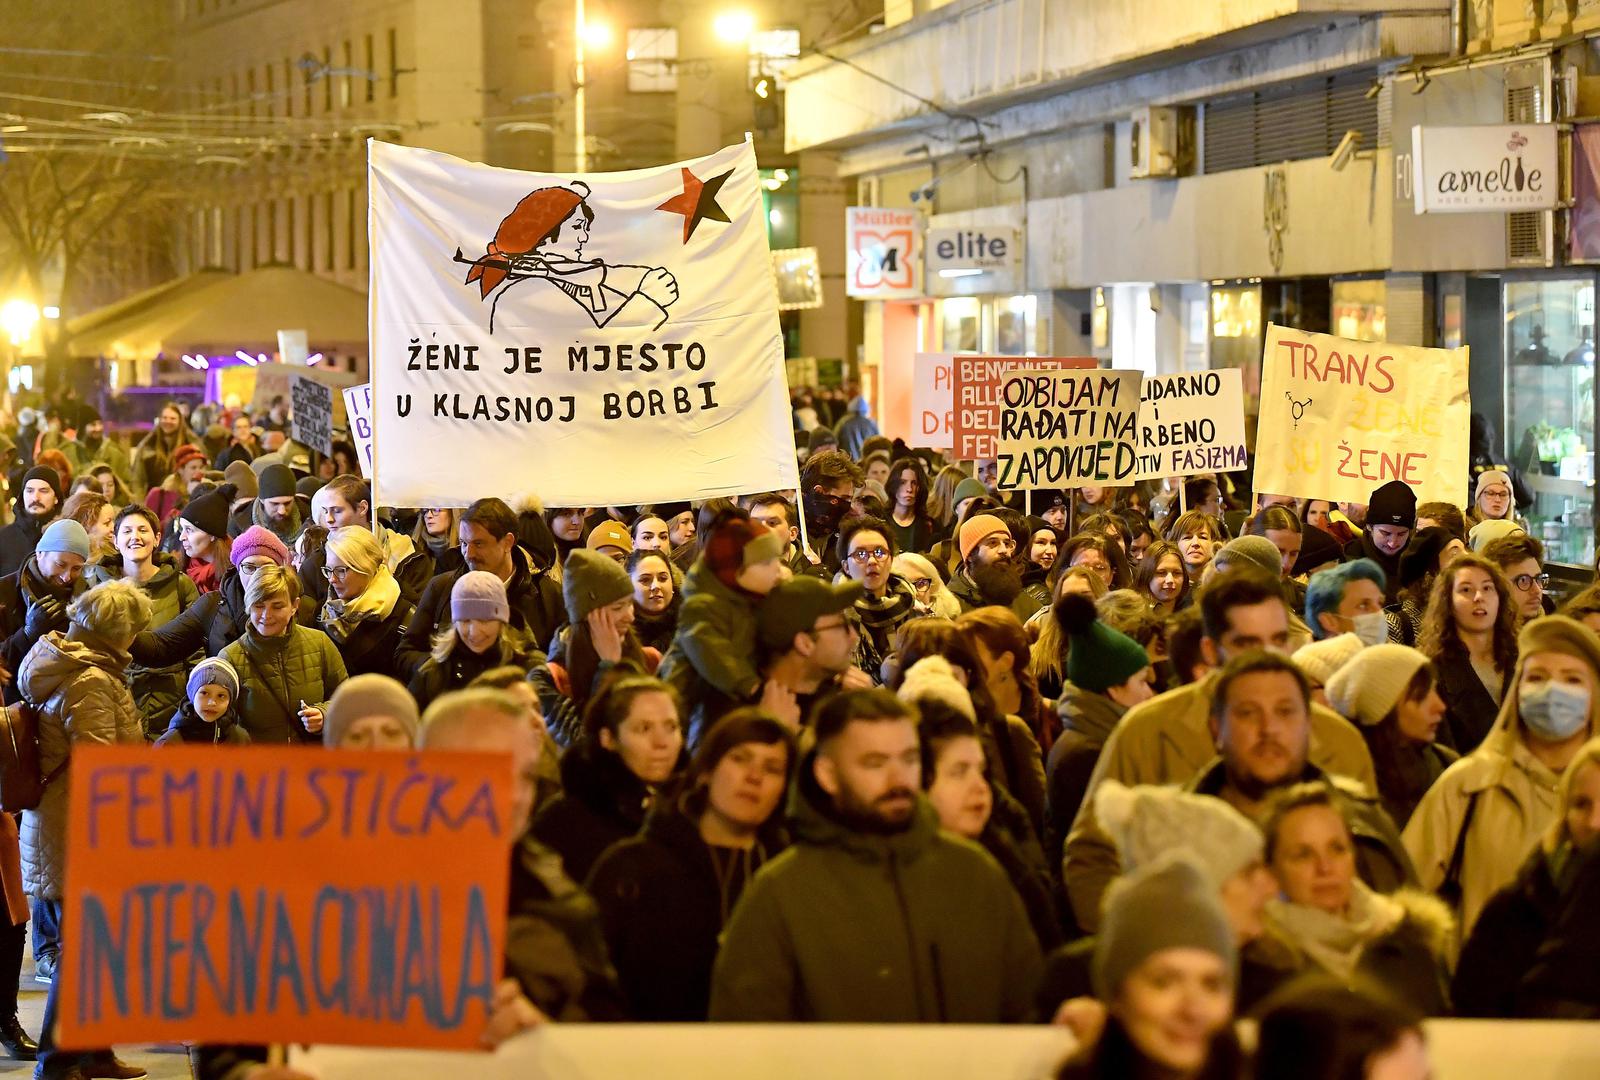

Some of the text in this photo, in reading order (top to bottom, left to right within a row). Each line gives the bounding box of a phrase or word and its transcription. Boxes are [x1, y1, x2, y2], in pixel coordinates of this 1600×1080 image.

[937, 232, 1006, 259] elite
[503, 347, 542, 374] JE
[568, 341, 706, 372] MJESTO
[1278, 341, 1395, 393] TRANS
[397, 394, 411, 417] U
[433, 393, 576, 422] KLASNOJ
[604, 381, 719, 420] BORBI
[1003, 377, 1120, 408] ODBIJAM
[1001, 409, 1136, 441] RAĐATI NA
[1136, 418, 1215, 448] RBENO
[997, 441, 1136, 489] ZAPOVIJED
[1172, 443, 1248, 472] FAŠIZMA
[1337, 440, 1427, 485] ŽENE
[88, 760, 500, 850] FEMINISTIČKA
[77, 881, 494, 1031] INTERNACIONALA
